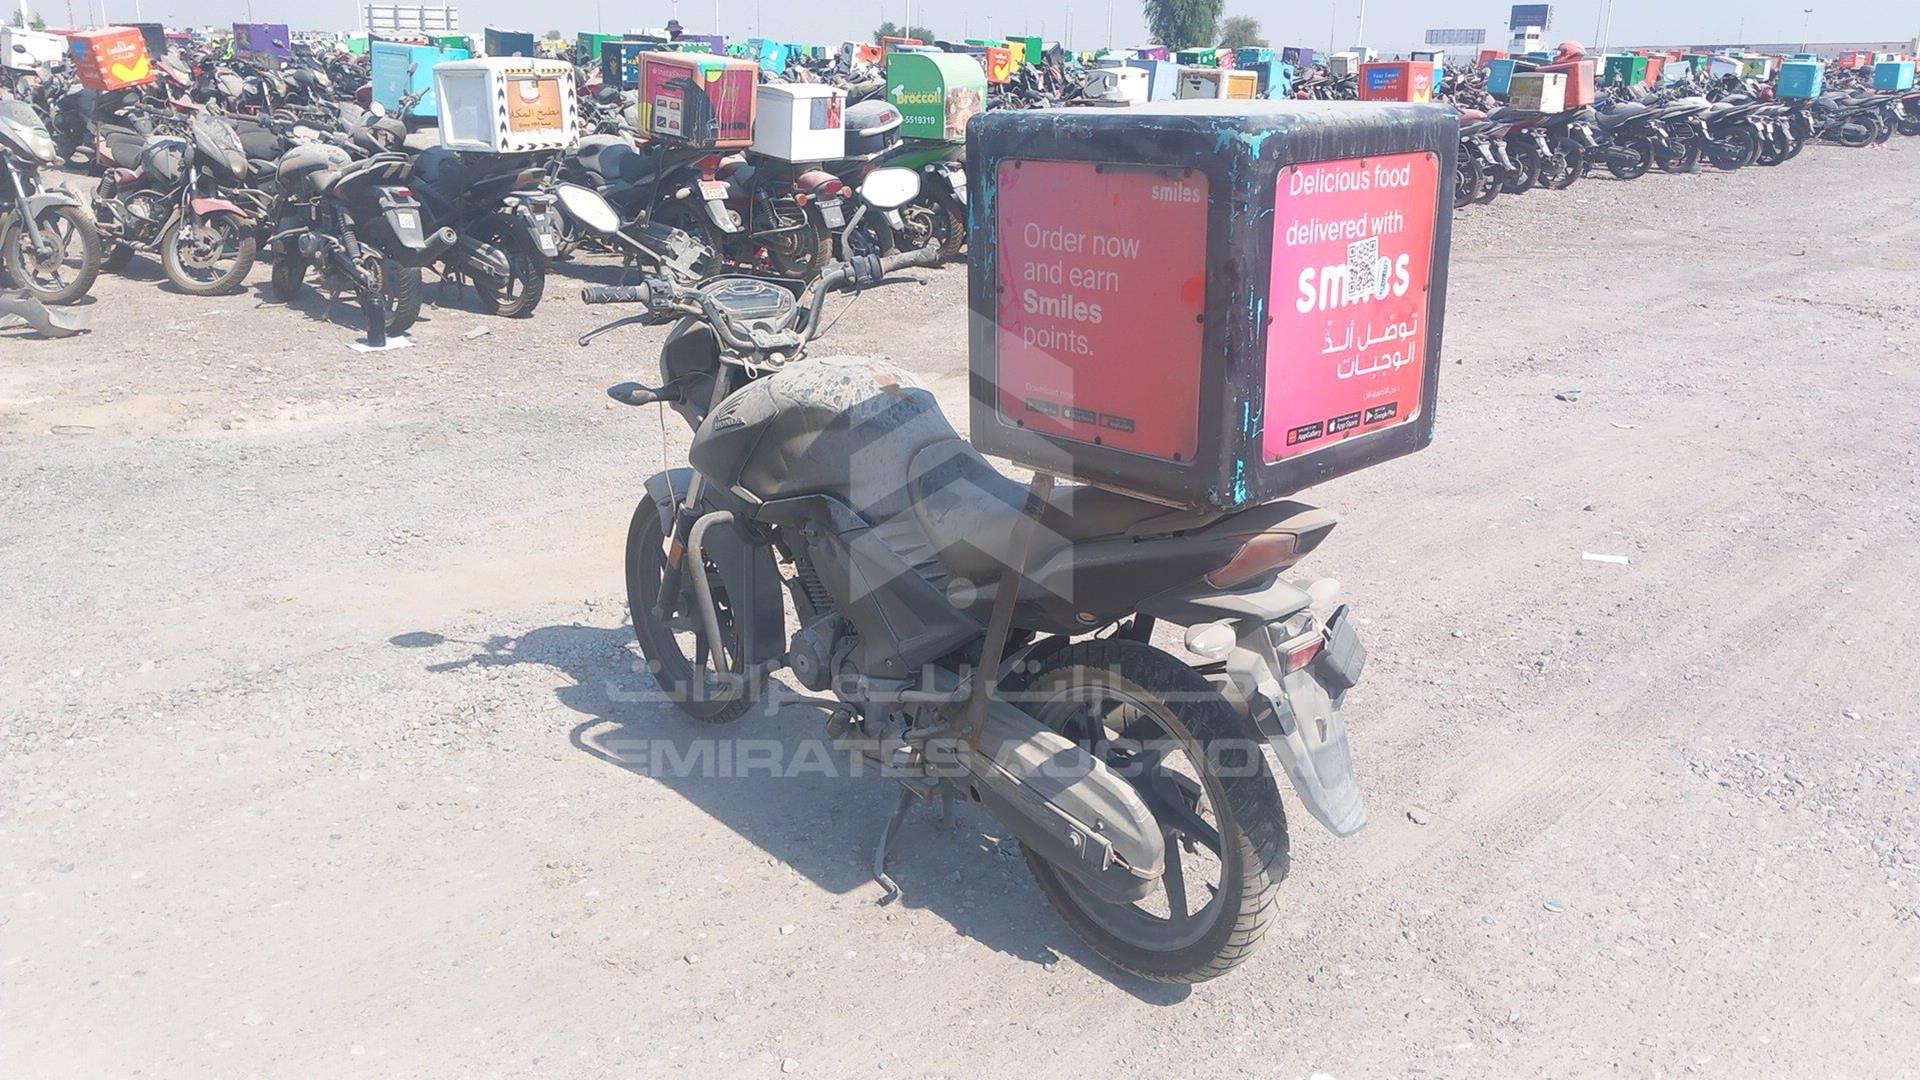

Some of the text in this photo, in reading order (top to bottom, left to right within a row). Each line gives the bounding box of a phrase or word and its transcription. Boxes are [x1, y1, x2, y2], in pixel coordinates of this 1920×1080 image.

[1152, 182, 1200, 203] smiles
[1290, 163, 1410, 196] Delicious food
[1024, 222, 1140, 260] Order now
[1286, 209, 1403, 246] delivered with
[1024, 260, 1119, 292] and earn
[1023, 288, 1103, 324] Smiles
[1023, 325, 1094, 356] points.
[1337, 341, 1416, 379] الوجبات
[714, 416, 745, 430] HONDA
